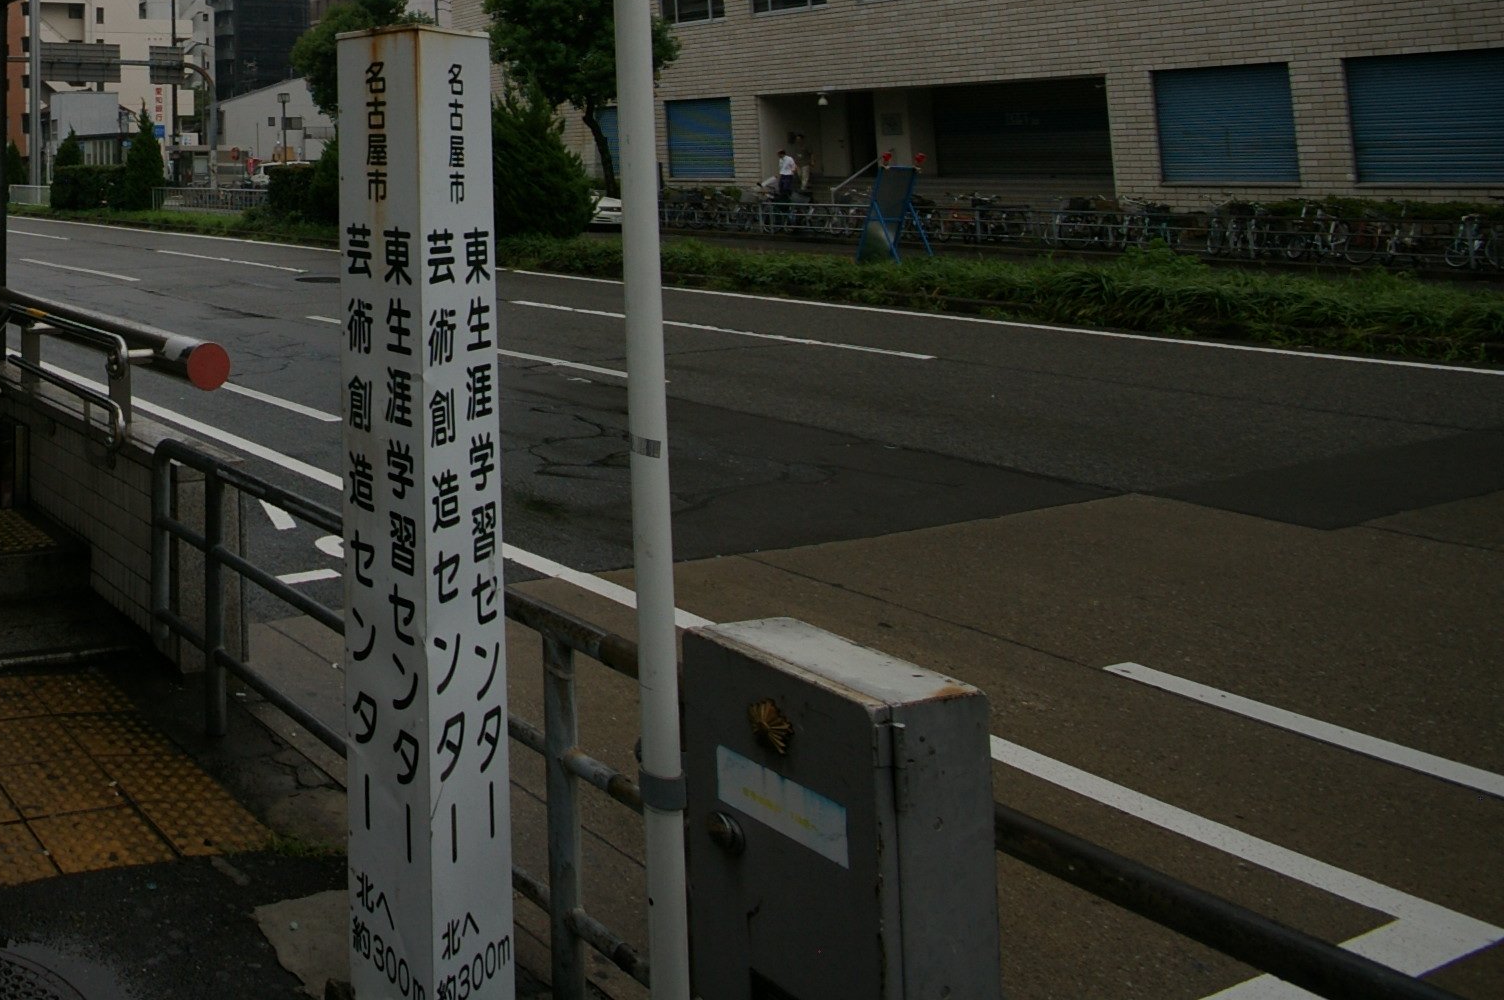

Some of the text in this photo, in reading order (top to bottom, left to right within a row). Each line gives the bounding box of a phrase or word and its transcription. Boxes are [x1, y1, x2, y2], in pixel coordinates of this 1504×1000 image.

[365, 60, 389, 204] 名古屋市
[447, 63, 466, 205] 名古屋市
[346, 222, 378, 831] 芸術創造センター
[382, 225, 420, 864] 東生涯学習センター
[426, 228, 467, 864] 芸術創造センター
[463, 226, 503, 839] 東生涯学習センター
[356, 872, 395, 931] 北へ
[441, 911, 480, 960] 北へ
